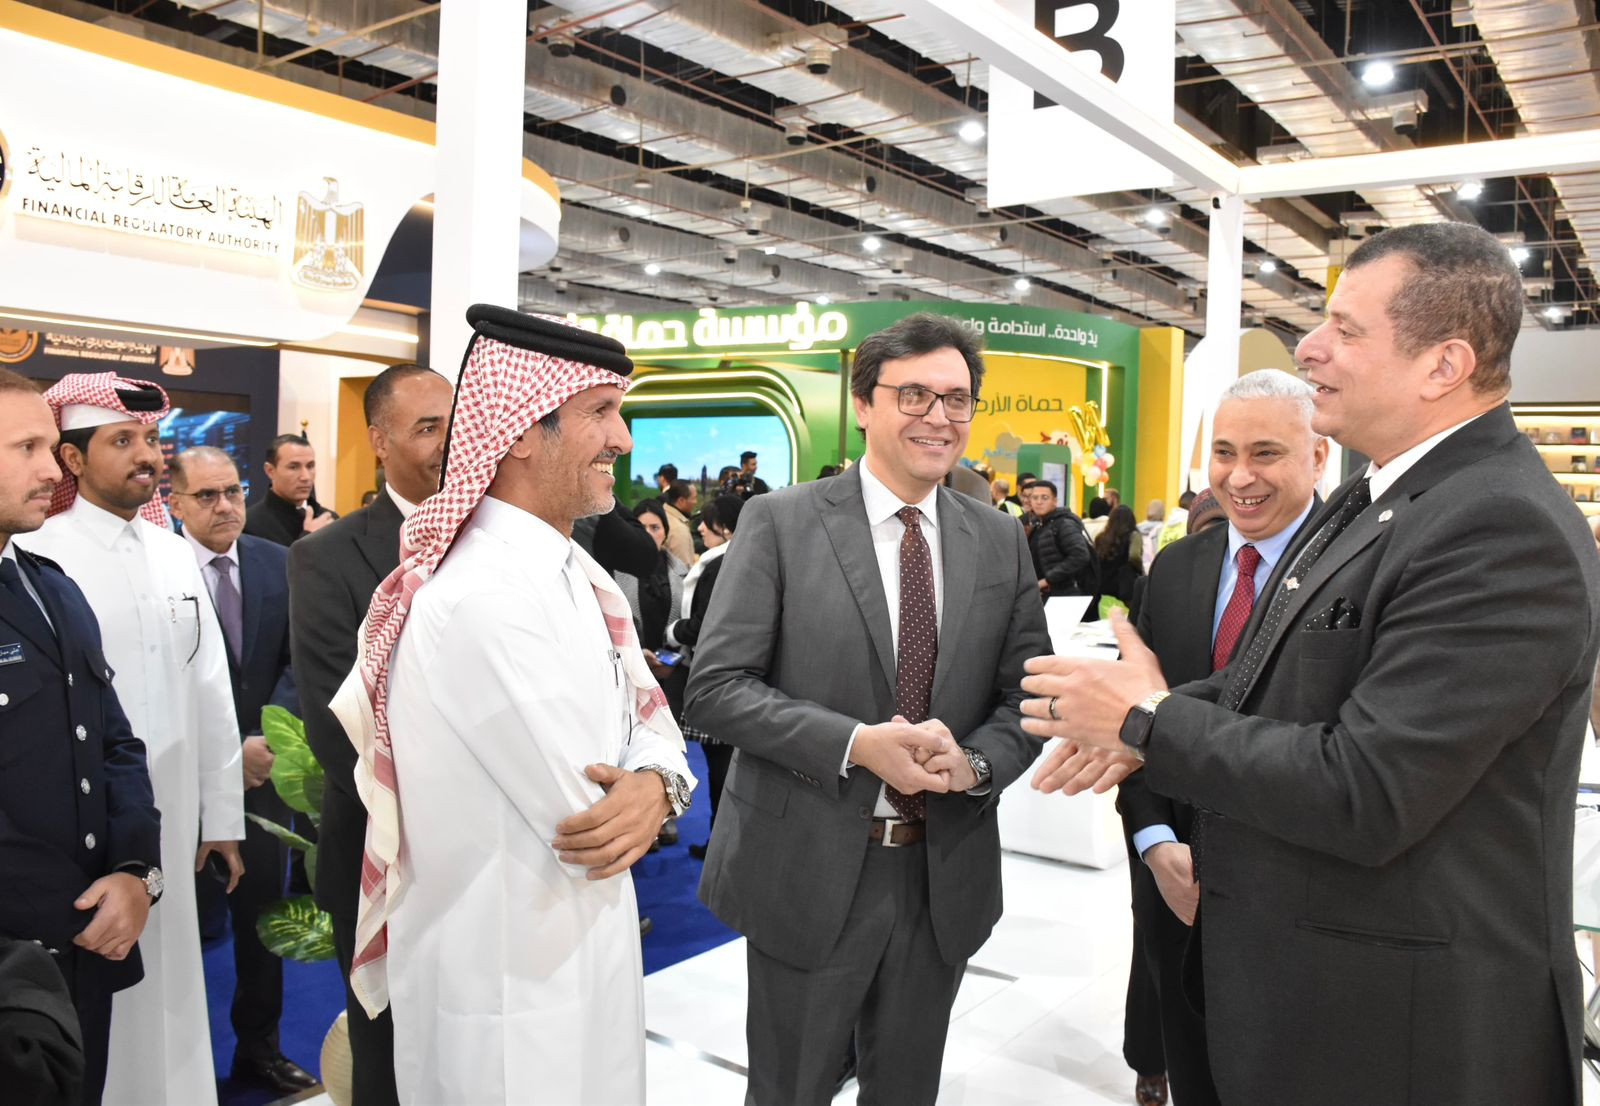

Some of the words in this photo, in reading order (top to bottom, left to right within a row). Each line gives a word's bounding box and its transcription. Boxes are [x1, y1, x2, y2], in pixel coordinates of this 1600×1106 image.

[1035, 0, 1124, 109] B
[22, 197, 107, 224] FINANCIAL
[113, 213, 202, 240] REGULATORY
[208, 231, 280, 253] AUTHORITY
[601, 313, 688, 349] حماة
[692, 301, 848, 351] مؤسسة
[988, 316, 1045, 338] استدامة
[1016, 393, 1063, 412] حماة
